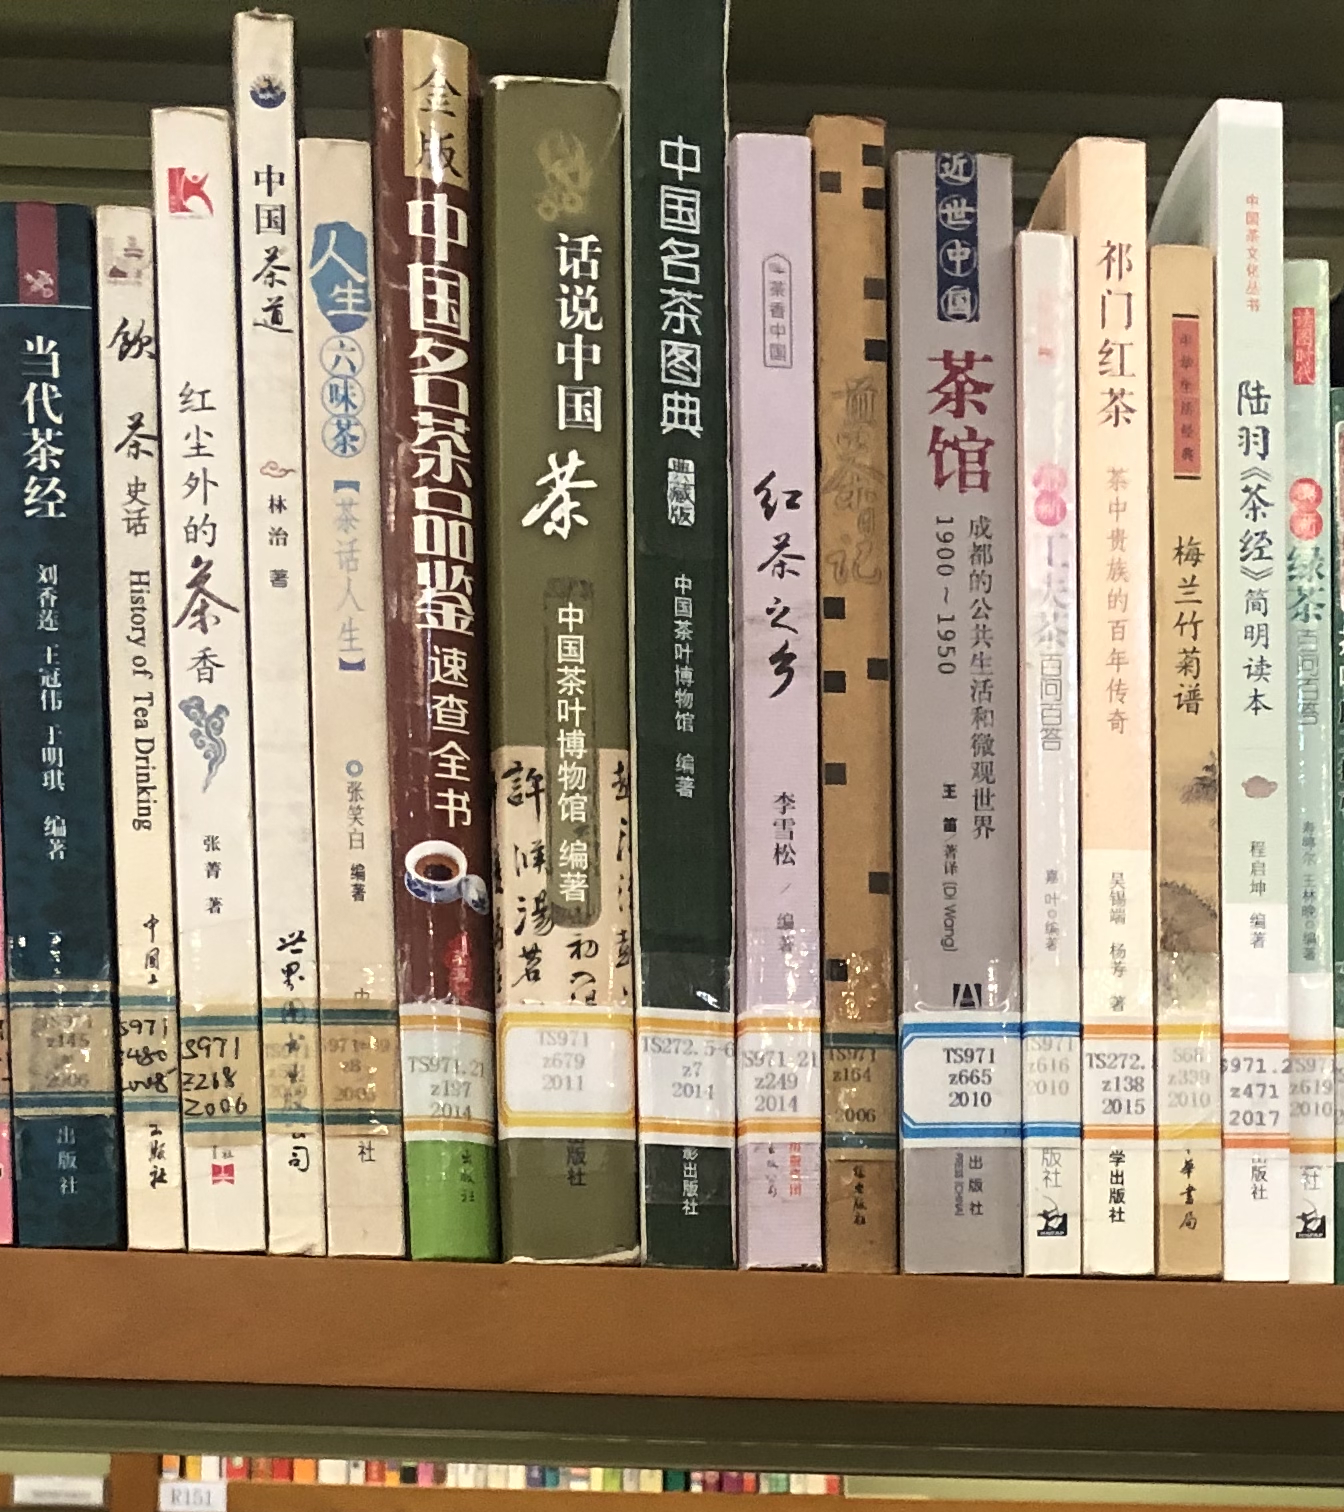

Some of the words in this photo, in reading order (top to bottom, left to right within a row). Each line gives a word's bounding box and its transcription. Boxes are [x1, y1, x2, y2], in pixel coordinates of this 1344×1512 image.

[251, 164, 294, 335] 中国茶道
[659, 135, 703, 439] 中国名茶图典
[937, 151, 978, 320] 近世中国
[1245, 192, 1261, 313] 中国茶文化丛书
[1096, 239, 1138, 428] 祁门红茶
[21, 335, 67, 520] 当代茶经
[927, 349, 995, 495] 茶馆
[172, 381, 240, 685] 红尘外的茶香
[267, 494, 289, 547] 林治
[405, 193, 475, 828] 中国名茶品鉴速查全书
[935, 515, 956, 576] 1900
[1235, 379, 1275, 715] 陆羽《茶经》简明读本
[128, 569, 150, 646] History
[752, 470, 807, 699] 红茶之乡
[936, 612, 957, 676] 1950
[1104, 465, 1130, 736] 茶中贵族的百年传奇
[1171, 535, 1205, 715] 梅兰竹菊谱
[131, 654, 150, 679] of
[132, 692, 154, 732] Tea
[556, 602, 588, 824] 中国茶叶博物馆
[673, 574, 695, 734] 中国茶叶博物馆
[967, 514, 996, 840] 成都的公共生活和微观世界
[134, 737, 155, 832] Drinking
[345, 781, 366, 851] 张笑白
[772, 791, 797, 866] 李雪松
[942, 1046, 996, 1065] TS971
[948, 1069, 993, 1086] z665
[948, 1090, 993, 1109] 2010
[1101, 1097, 1146, 1116] 2015
[1229, 1083, 1280, 1101] z471
[1229, 1109, 1281, 1128] 2017
